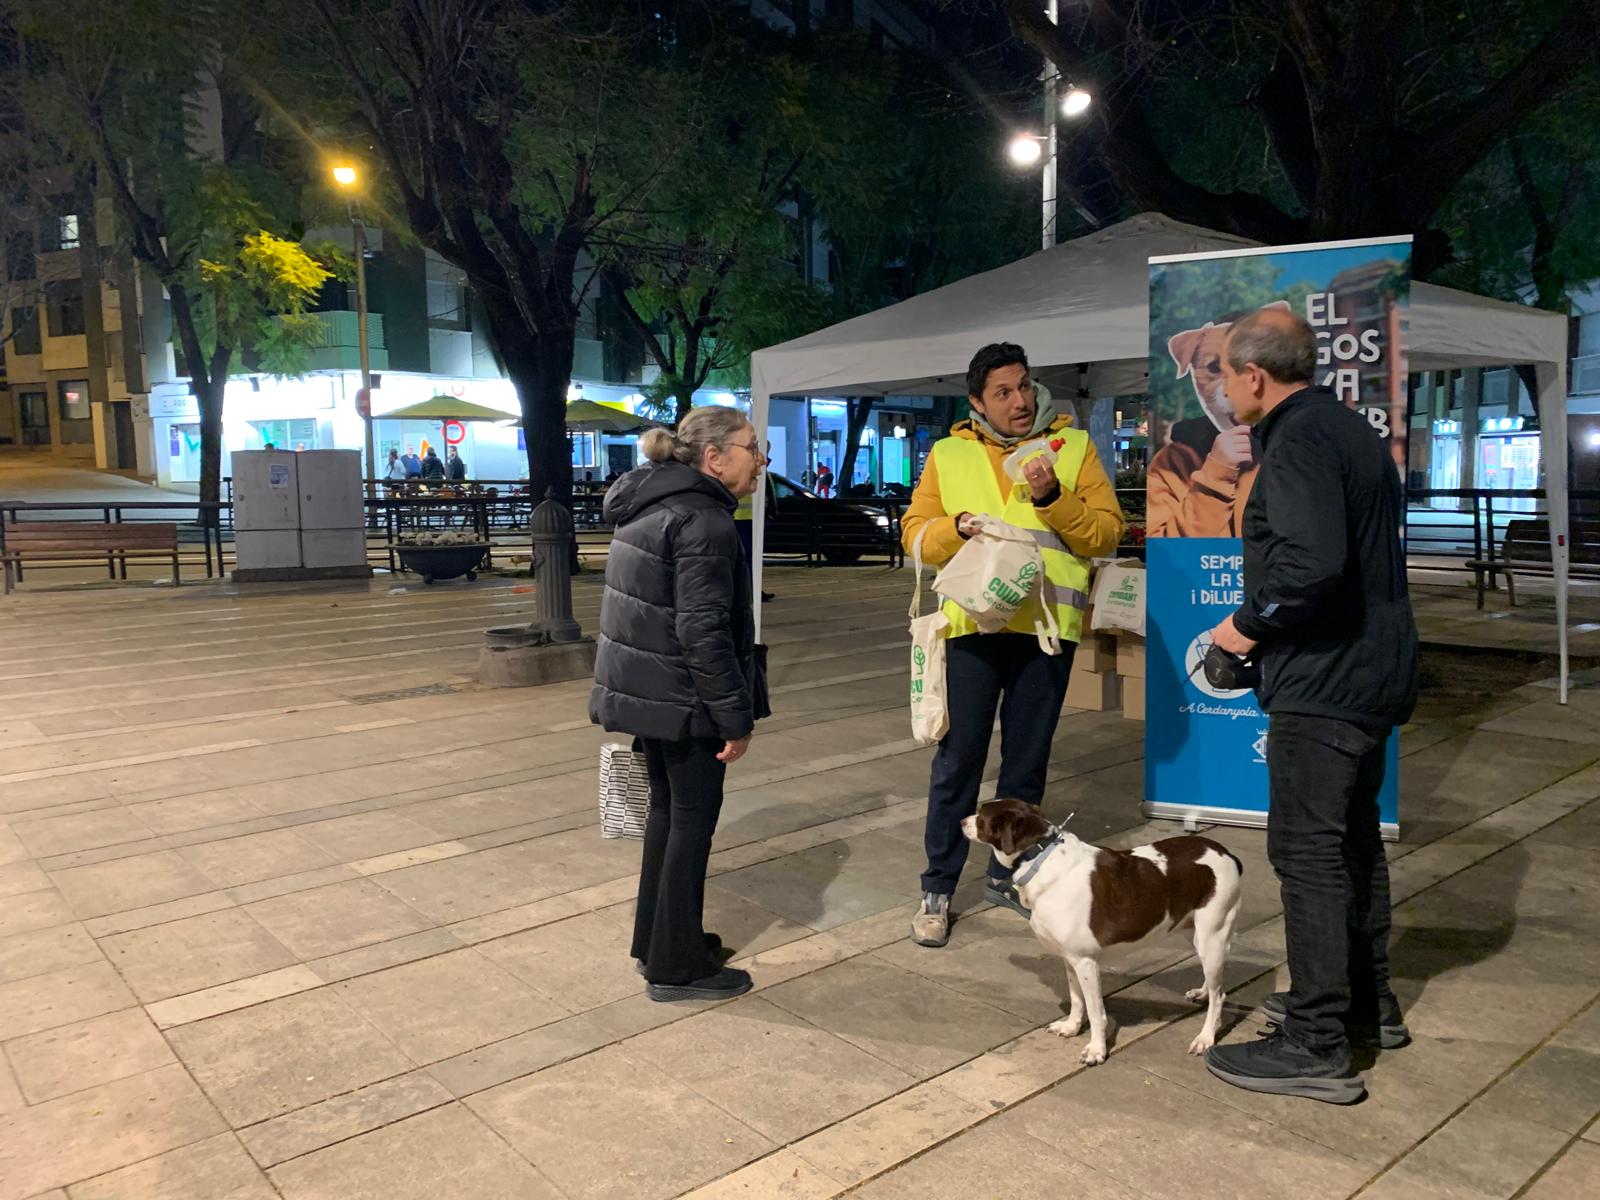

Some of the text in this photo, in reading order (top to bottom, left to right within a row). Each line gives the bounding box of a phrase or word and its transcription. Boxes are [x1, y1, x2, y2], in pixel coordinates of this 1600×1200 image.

[1306, 293, 1348, 326] EL
[1200, 555, 1244, 570] SEMP
[1211, 573, 1244, 587] LA S
[988, 577, 1024, 606] CUID
[1200, 589, 1244, 605] DiLUE
[1179, 703, 1196, 713] A
